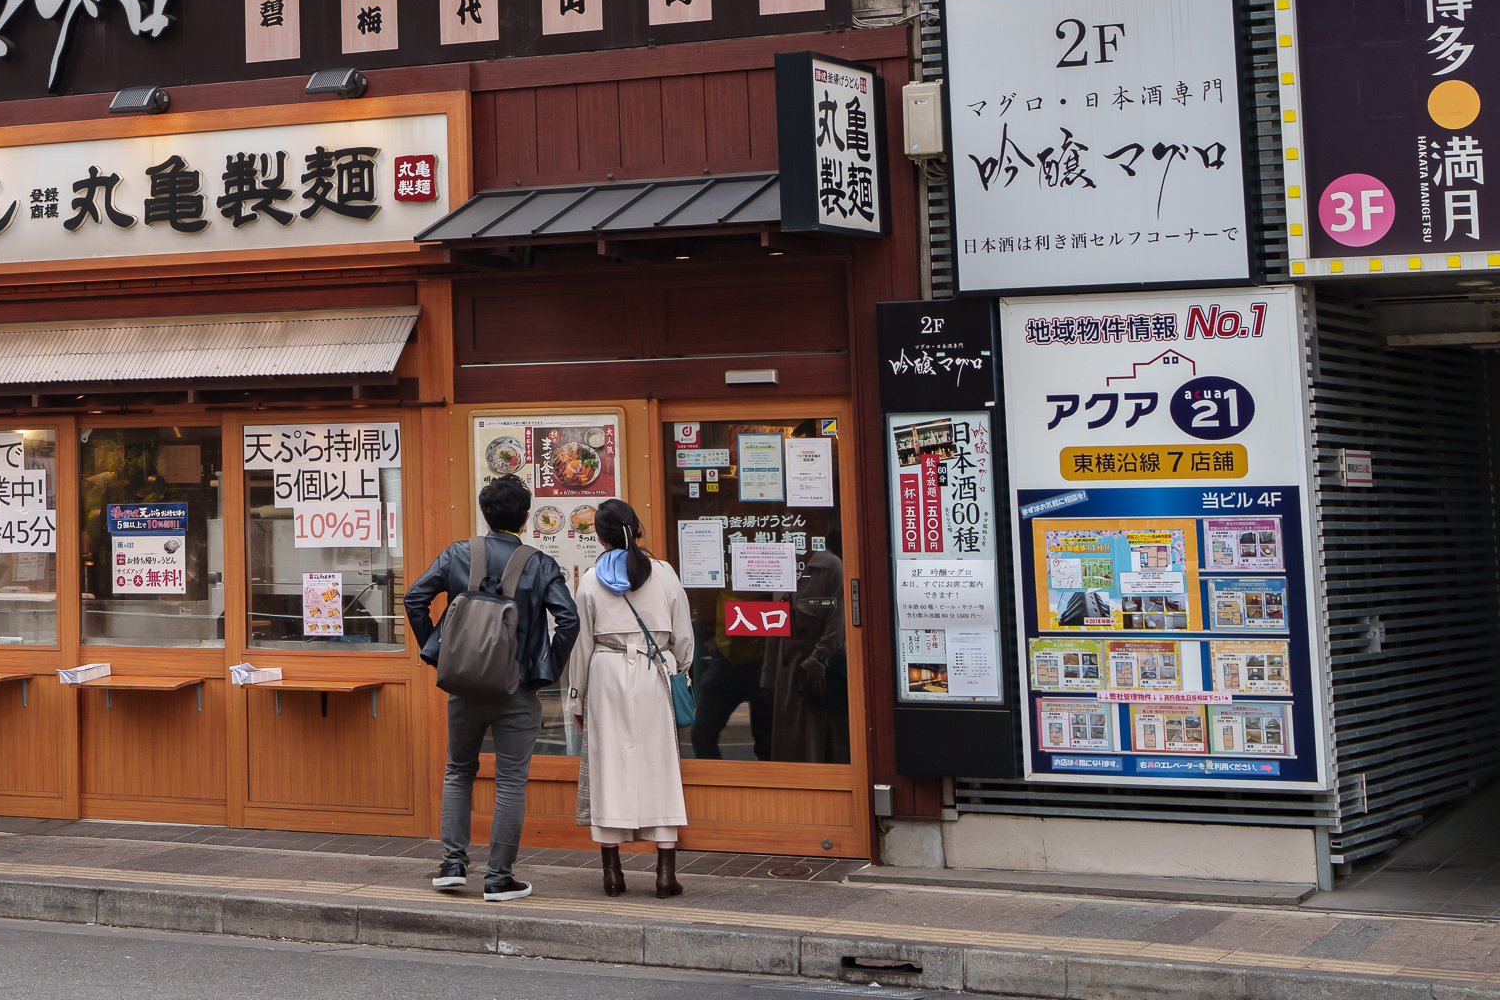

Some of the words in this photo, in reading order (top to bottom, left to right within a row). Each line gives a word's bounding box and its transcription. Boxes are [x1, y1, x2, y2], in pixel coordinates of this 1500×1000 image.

[1054, 18, 1126, 68] 2F
[967, 78, 1224, 118] マグロ・日本酒専門
[1417, 135, 1429, 182] HAKATA
[63, 145, 382, 234] 丸亀製麺
[1432, 134, 1485, 243] 満月
[1330, 189, 1384, 232] 3F
[1420, 183, 1433, 244] MANGETSU
[963, 226, 1239, 255] 日本酒は利き酒セルフコーナーで
[920, 315, 945, 334] 2F
[1025, 313, 1178, 345] 地域物件情報
[1184, 302, 1268, 340] No.1
[1045, 391, 1159, 431] アクア
[1191, 387, 1239, 428] 21
[243, 428, 400, 464] 天ぷら持帰り
[275, 468, 379, 502] 5個以上
[950, 420, 981, 553] 日本酒60種
[1201, 492, 1254, 509] 当ビル
[1257, 491, 1282, 508] 4F
[294, 511, 395, 541] 10%引!
[728, 514, 807, 529] 釜揚げうどん
[145, 568, 183, 588] 無料!
[727, 605, 788, 632] 入口
